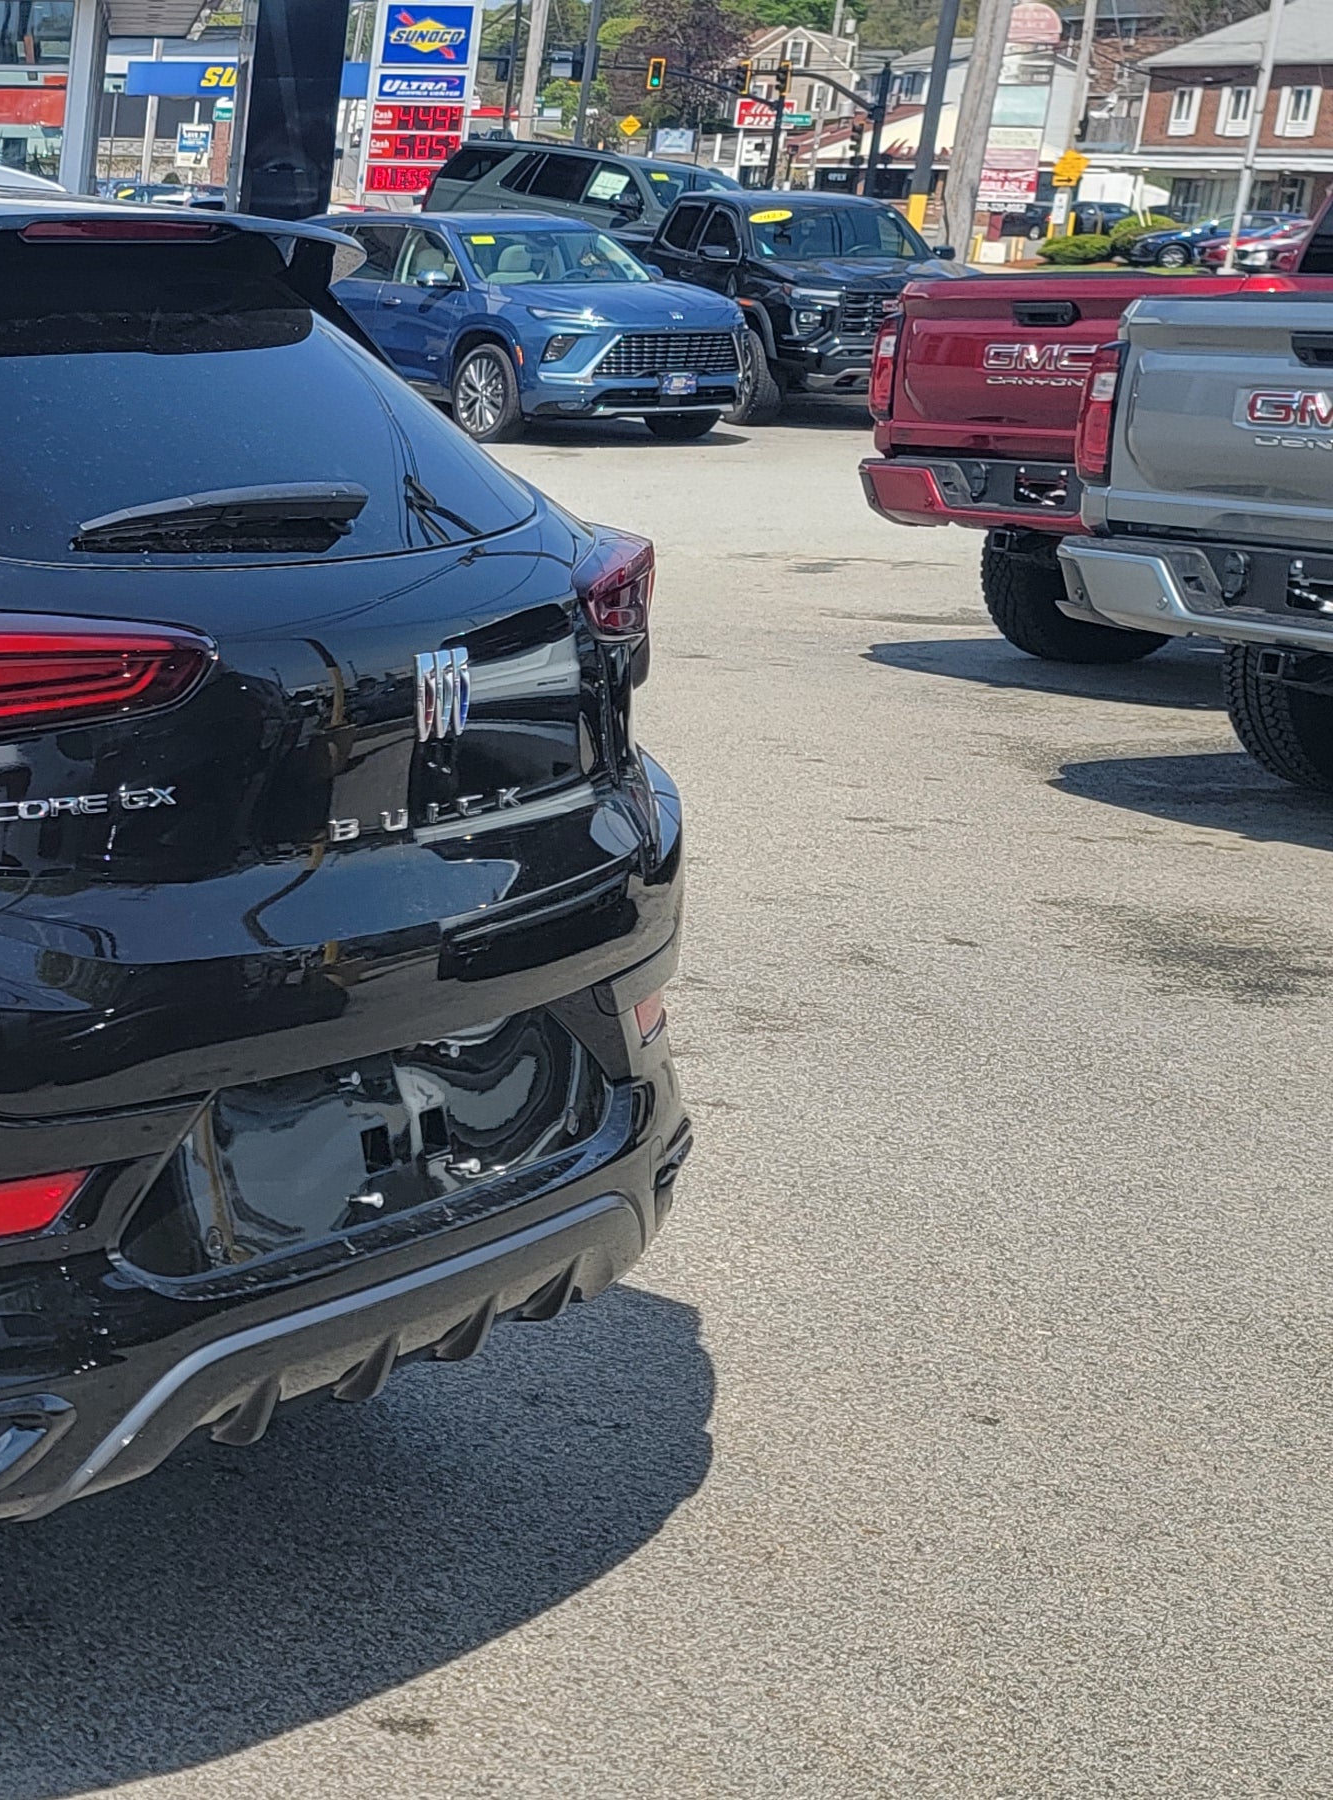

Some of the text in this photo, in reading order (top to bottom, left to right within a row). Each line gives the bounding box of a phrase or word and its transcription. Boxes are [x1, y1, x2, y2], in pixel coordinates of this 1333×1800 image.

[393, 28, 465, 44] SUNOCO
[382, 79, 448, 92] ULTRA
[374, 109, 393, 119] Cash
[743, 115, 777, 126] PIZZ
[371, 139, 390, 149] Cash
[983, 343, 1100, 372] GMC
[985, 376, 1085, 387] CANYON
[1247, 390, 1333, 427] GM
[1254, 434, 1333, 451] DEN
[118, 783, 178, 811] GX
[327, 786, 522, 842] BUICK
